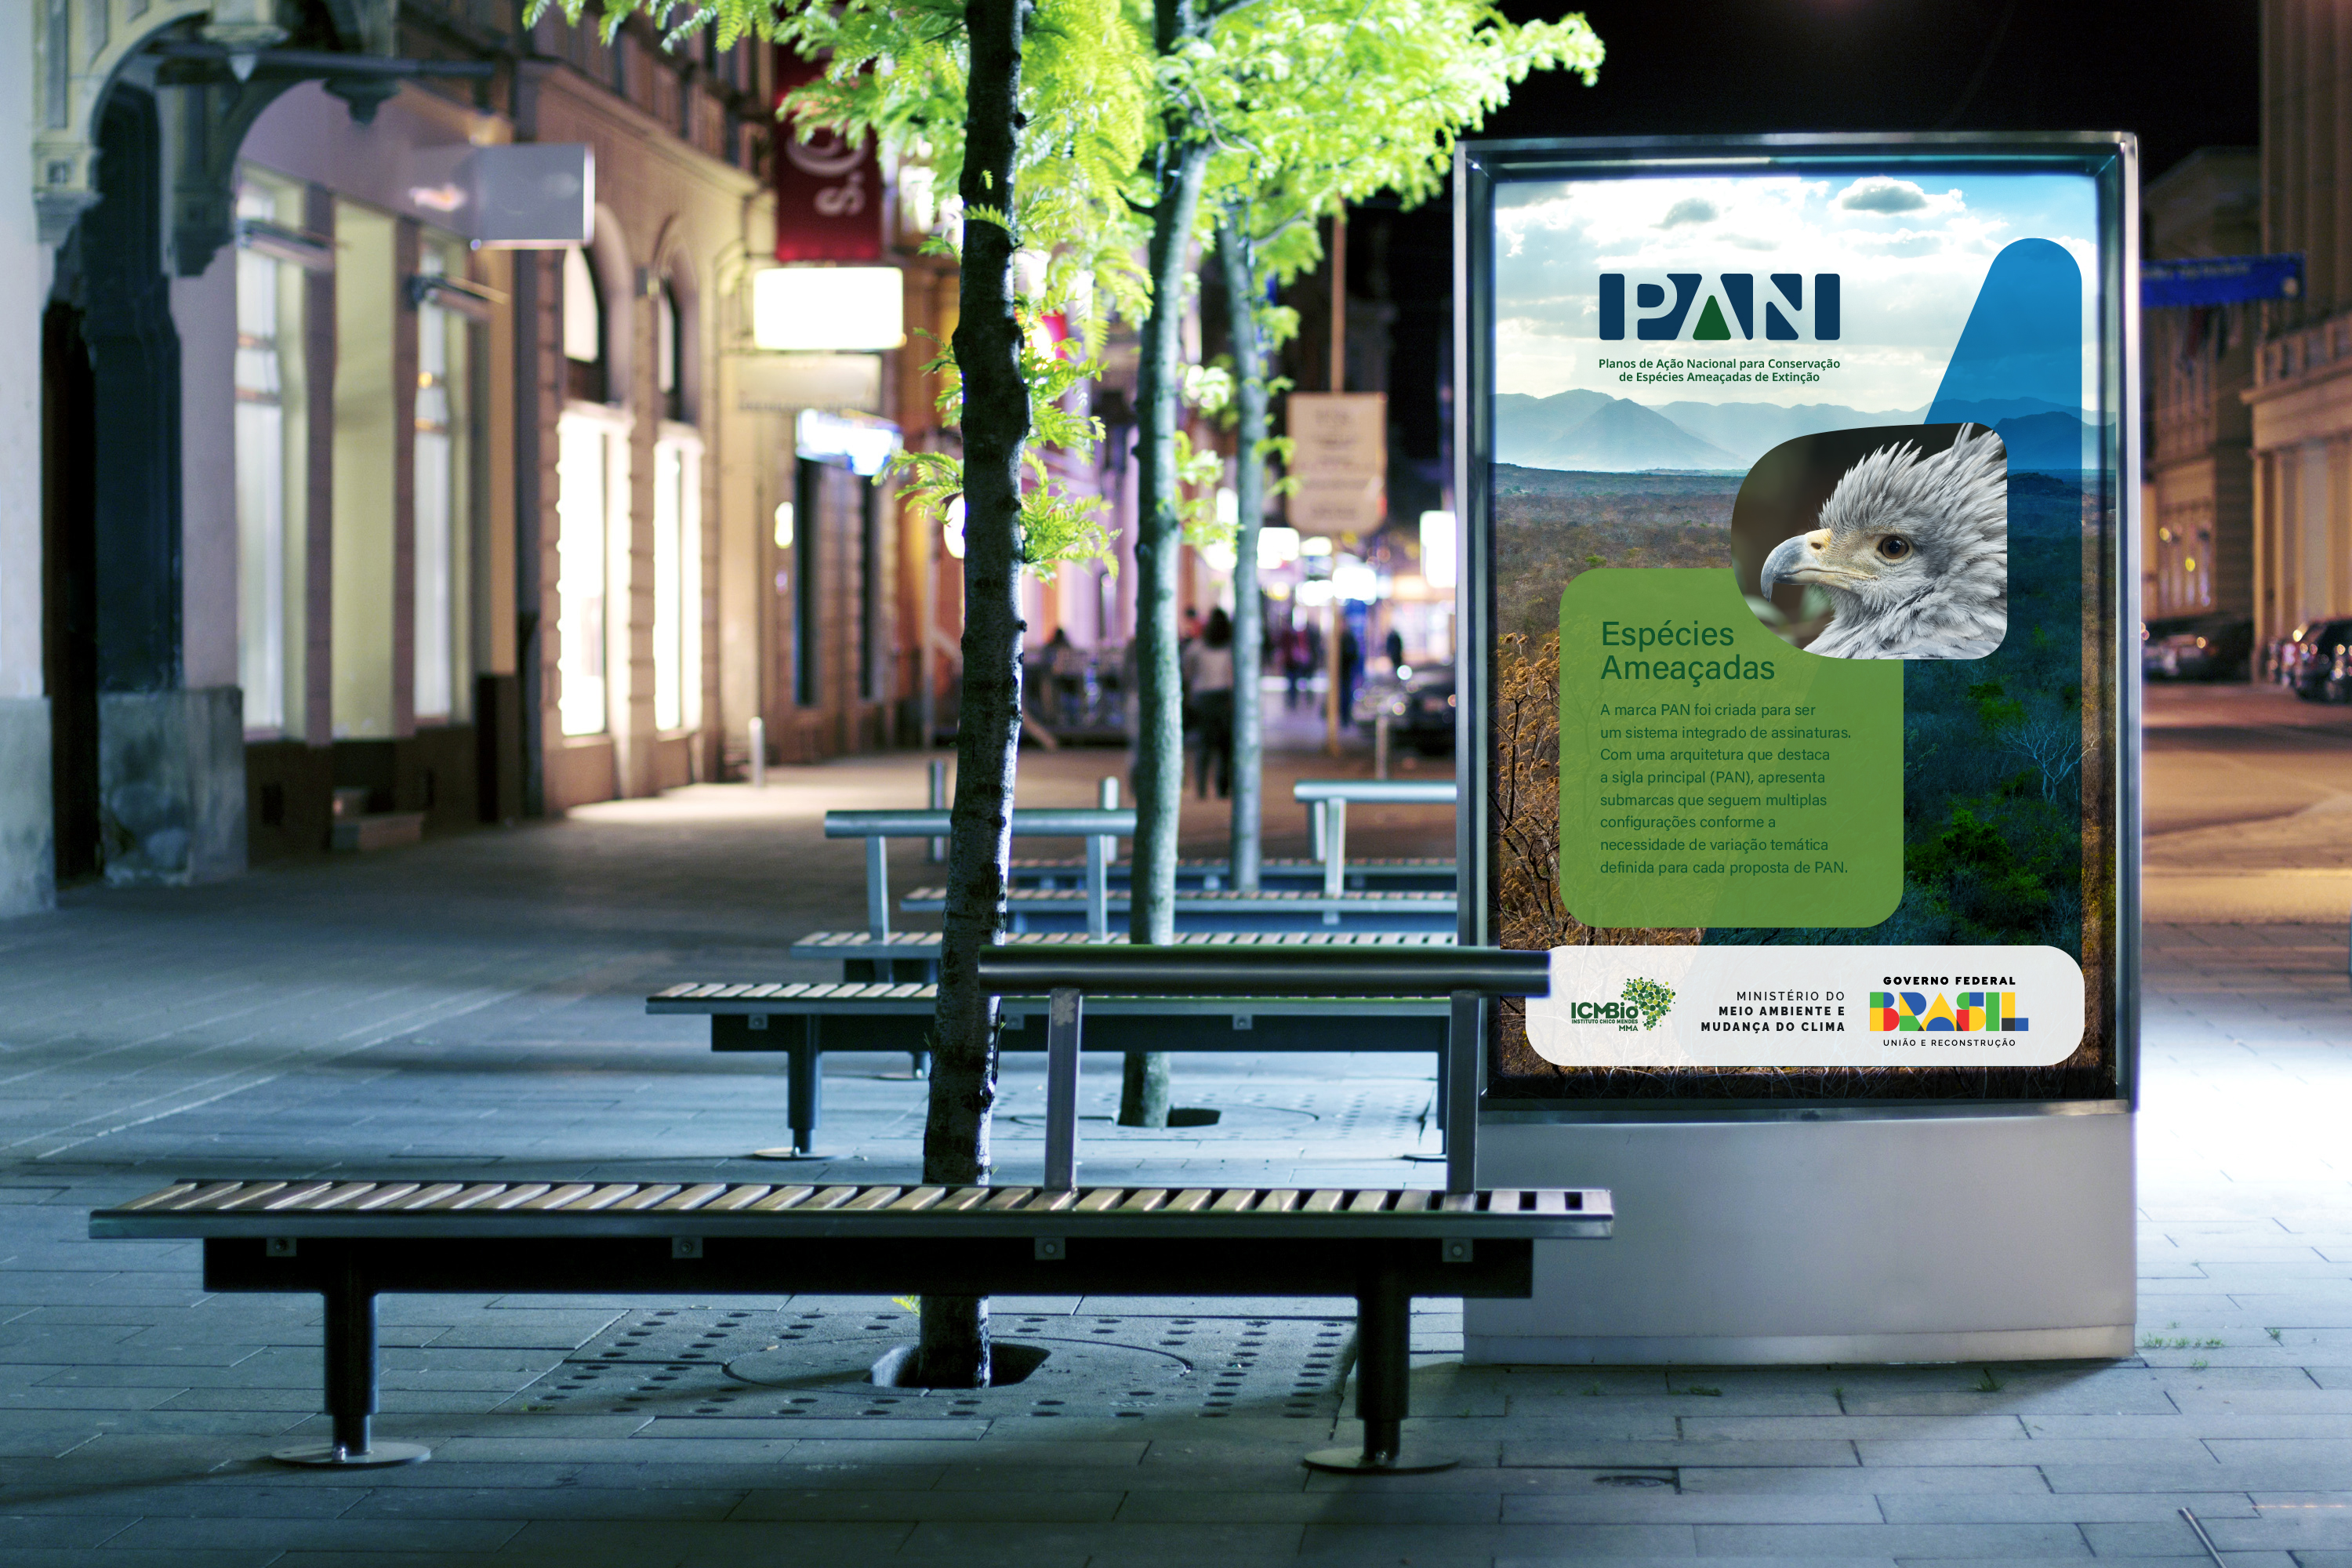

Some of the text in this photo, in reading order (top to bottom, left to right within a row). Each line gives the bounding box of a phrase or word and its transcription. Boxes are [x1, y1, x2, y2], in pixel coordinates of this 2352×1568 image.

[1599, 273, 1841, 341] PAN
[1598, 358, 1841, 372] Planos de Ação Nacional para Conservação
[1619, 372, 1820, 385] de Espécies Ameaçadas de Extinção
[1602, 619, 1734, 653] Espécies
[1600, 654, 1775, 688] Ameaçadas
[1600, 702, 1817, 719] A marca PAN foi criada para ser
[1600, 725, 1851, 742] um sistema integrado de assinaturas.
[1600, 747, 1830, 764] Com uma arquitetura que destaca
[1600, 770, 1825, 786] a sigla principal (PAN), apresenta
[1600, 793, 1828, 809] submarcas que seguem multiplas
[1600, 815, 1776, 832] configurações conforme a
[1600, 837, 1828, 855] necessidade de variação temática
[1600, 860, 1848, 877] definida para cada proposta de PAN.
[1882, 976, 2016, 985] GOVERNO FEDERAL
[1737, 989, 1845, 1001] MINISTÉRIO DO
[1570, 1001, 1639, 1020] ICMBio
[1719, 1006, 1845, 1016] MEIO AMBIENTE E
[1869, 991, 2030, 1033] BRASIL
[1700, 1022, 1845, 1034] MUDANÇA DO CLIMA
[1883, 1037, 1916, 1047] UNIÃO
[1931, 1037, 2016, 1048] RECONSTRUÇÃO
